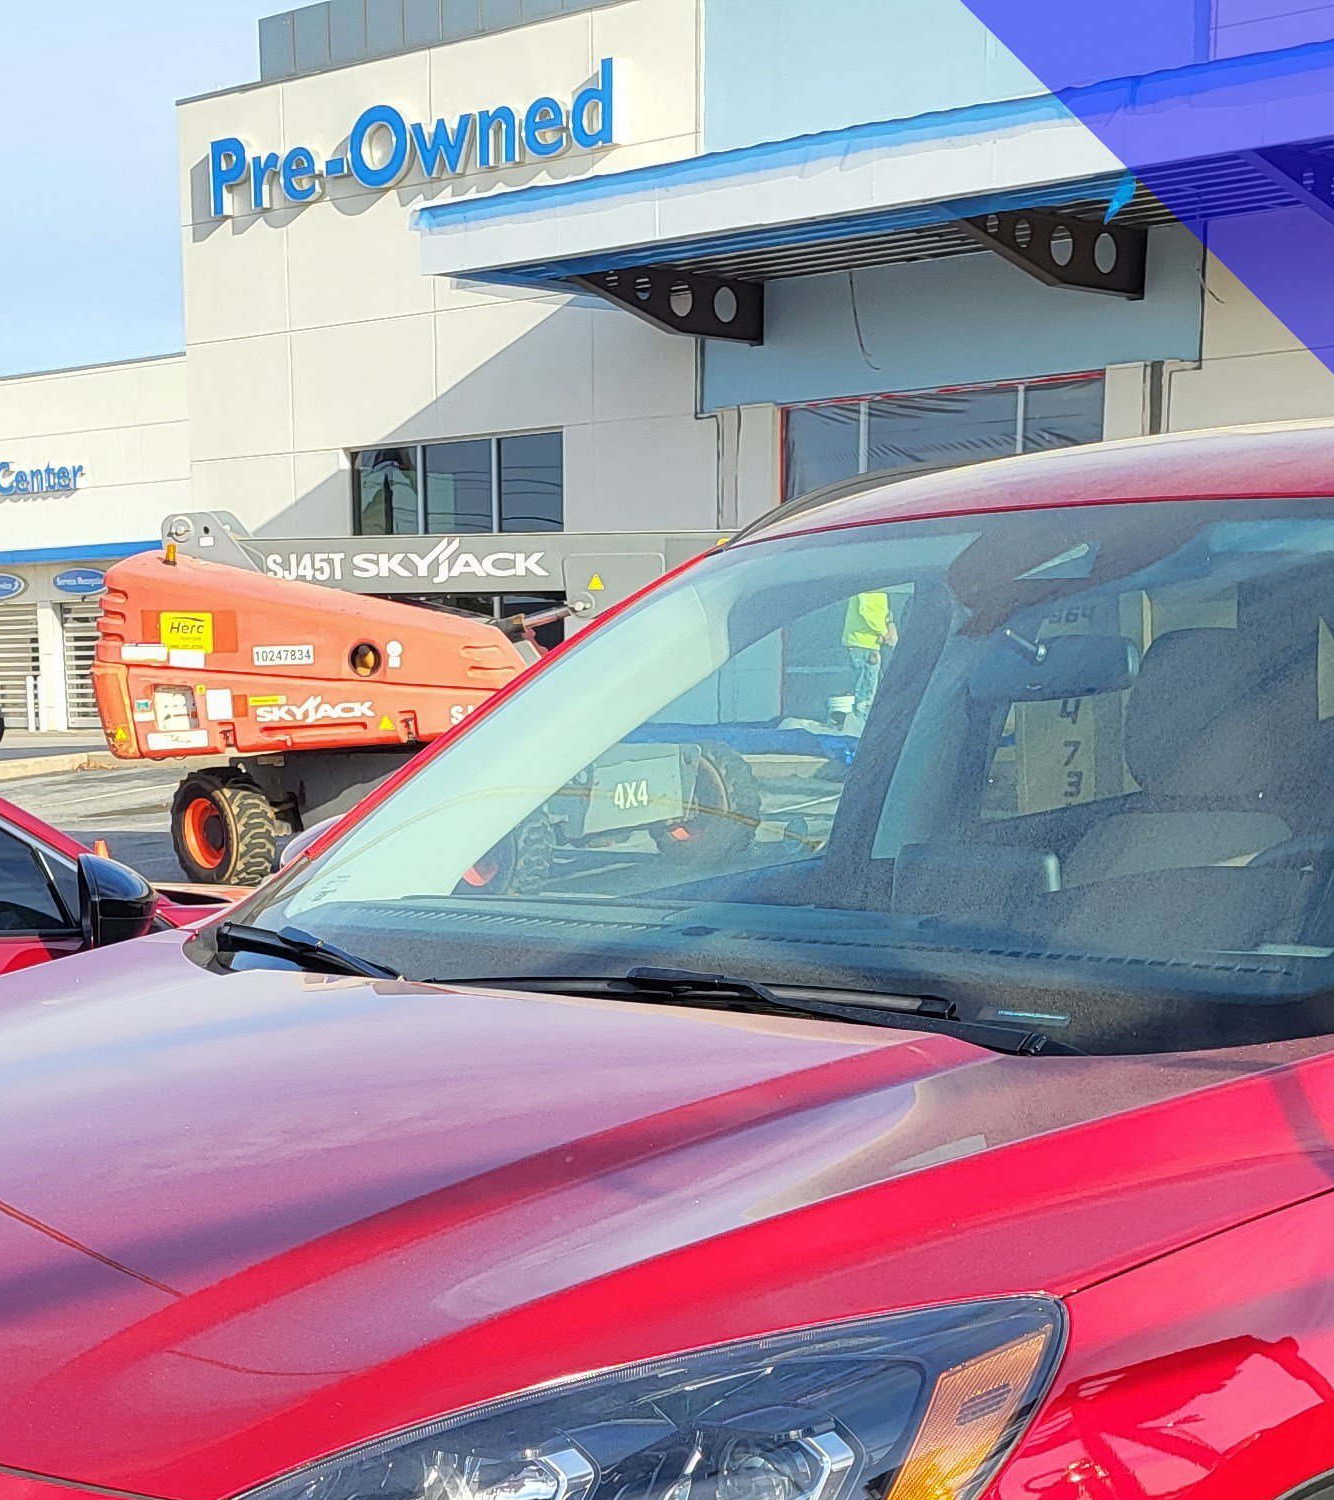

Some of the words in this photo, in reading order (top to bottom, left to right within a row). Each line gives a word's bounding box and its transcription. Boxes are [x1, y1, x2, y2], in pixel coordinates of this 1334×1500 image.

[208, 57, 613, 217] Pre-Owned
[267, 552, 345, 581] SJ45T
[352, 537, 550, 584] SKYJACK
[169, 621, 204, 634] Herc
[255, 650, 312, 662] 10247834
[256, 694, 375, 723] SKYJACK
[613, 779, 649, 810] 4X4
